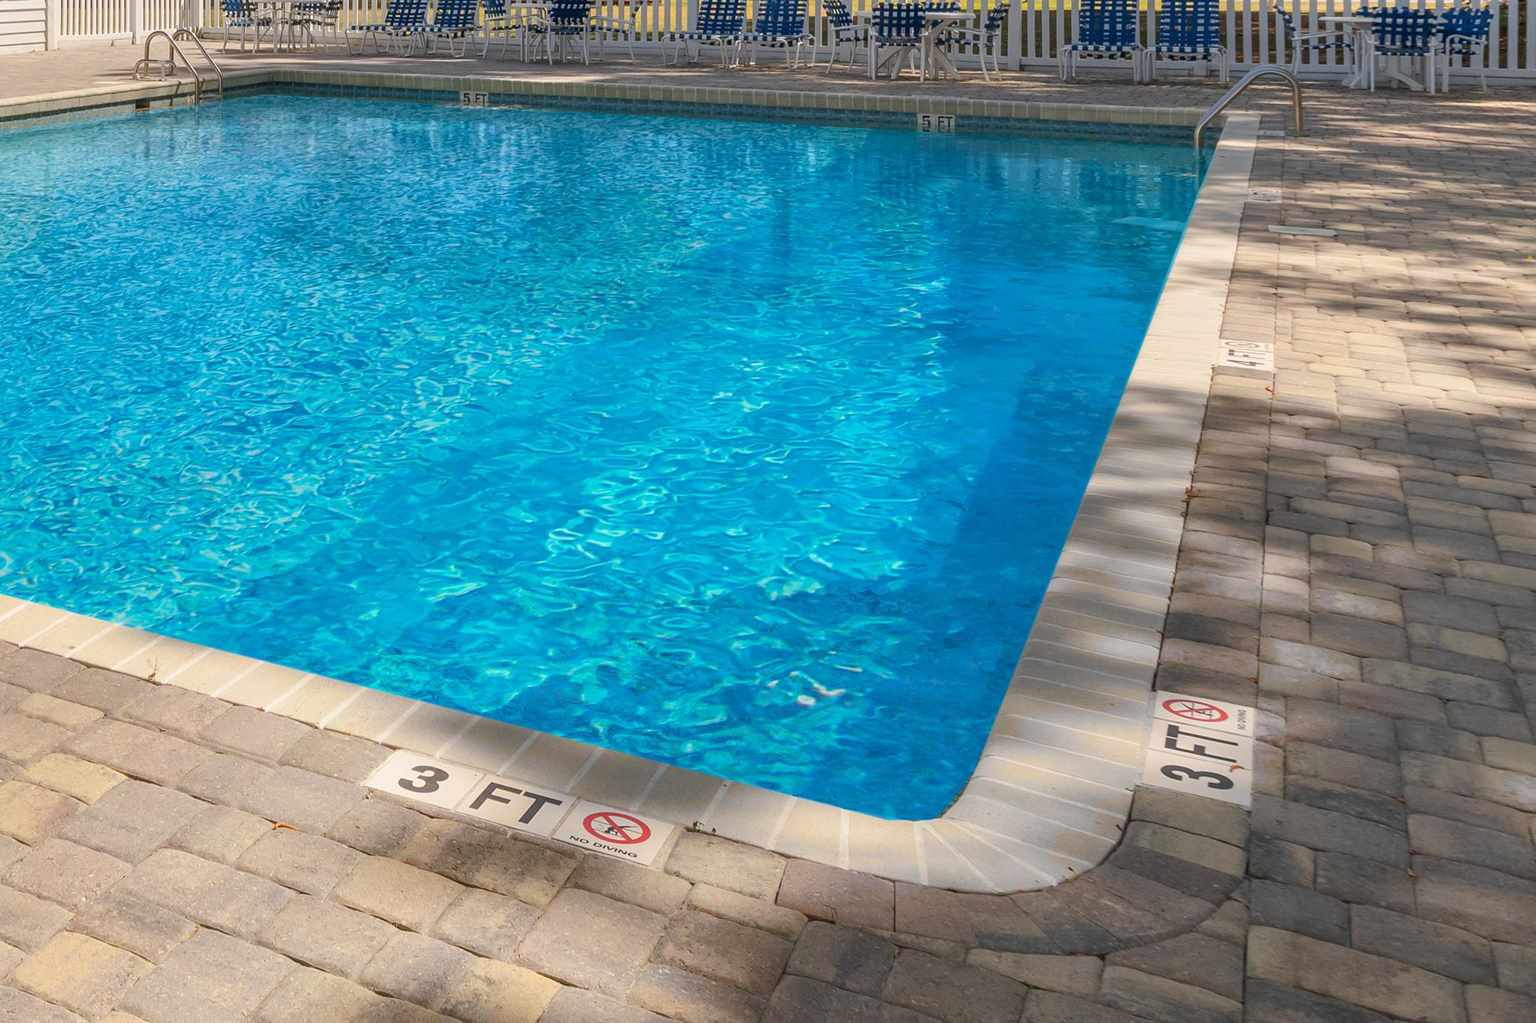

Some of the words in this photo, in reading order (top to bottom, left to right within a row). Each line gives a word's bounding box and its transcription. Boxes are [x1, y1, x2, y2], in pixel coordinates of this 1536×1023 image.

[475, 93, 487, 105] FT
[938, 115, 953, 130] FT
[1164, 724, 1239, 763] FT
[1160, 764, 1234, 790] 3
[398, 765, 449, 793] 3
[469, 782, 562, 824] FT
[569, 835, 589, 844] NO
[593, 842, 638, 857] DIVING
